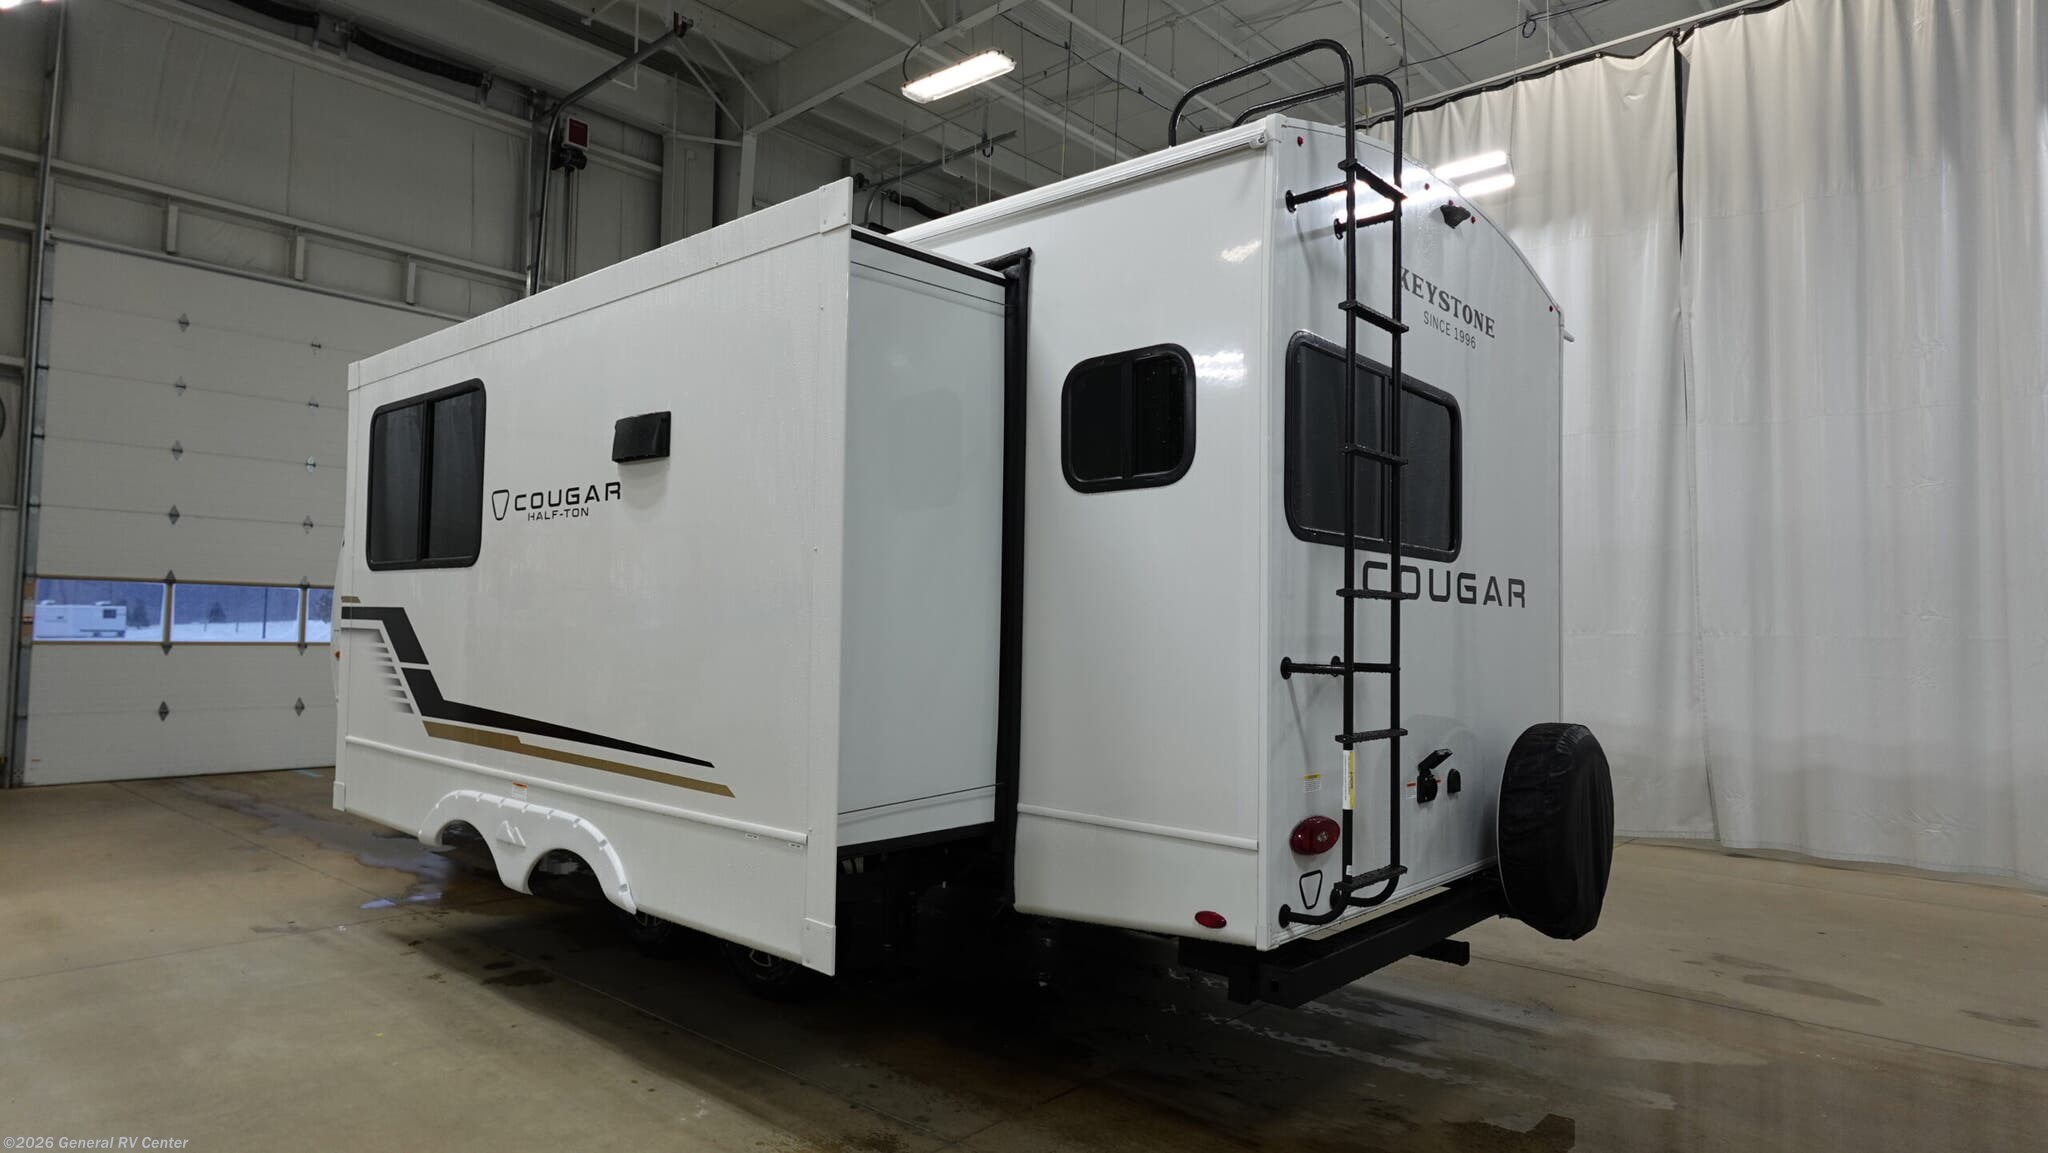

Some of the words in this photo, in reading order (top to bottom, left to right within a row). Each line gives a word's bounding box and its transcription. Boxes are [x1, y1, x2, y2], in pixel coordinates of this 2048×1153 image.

[1400, 266, 1496, 339] KEYSTONE
[1423, 310, 1451, 336] SINCE
[1454, 327, 1477, 350] 1996
[514, 481, 622, 511] COUGAR
[527, 506, 590, 522] HALF-TON
[1362, 560, 1526, 609] COUGAR
